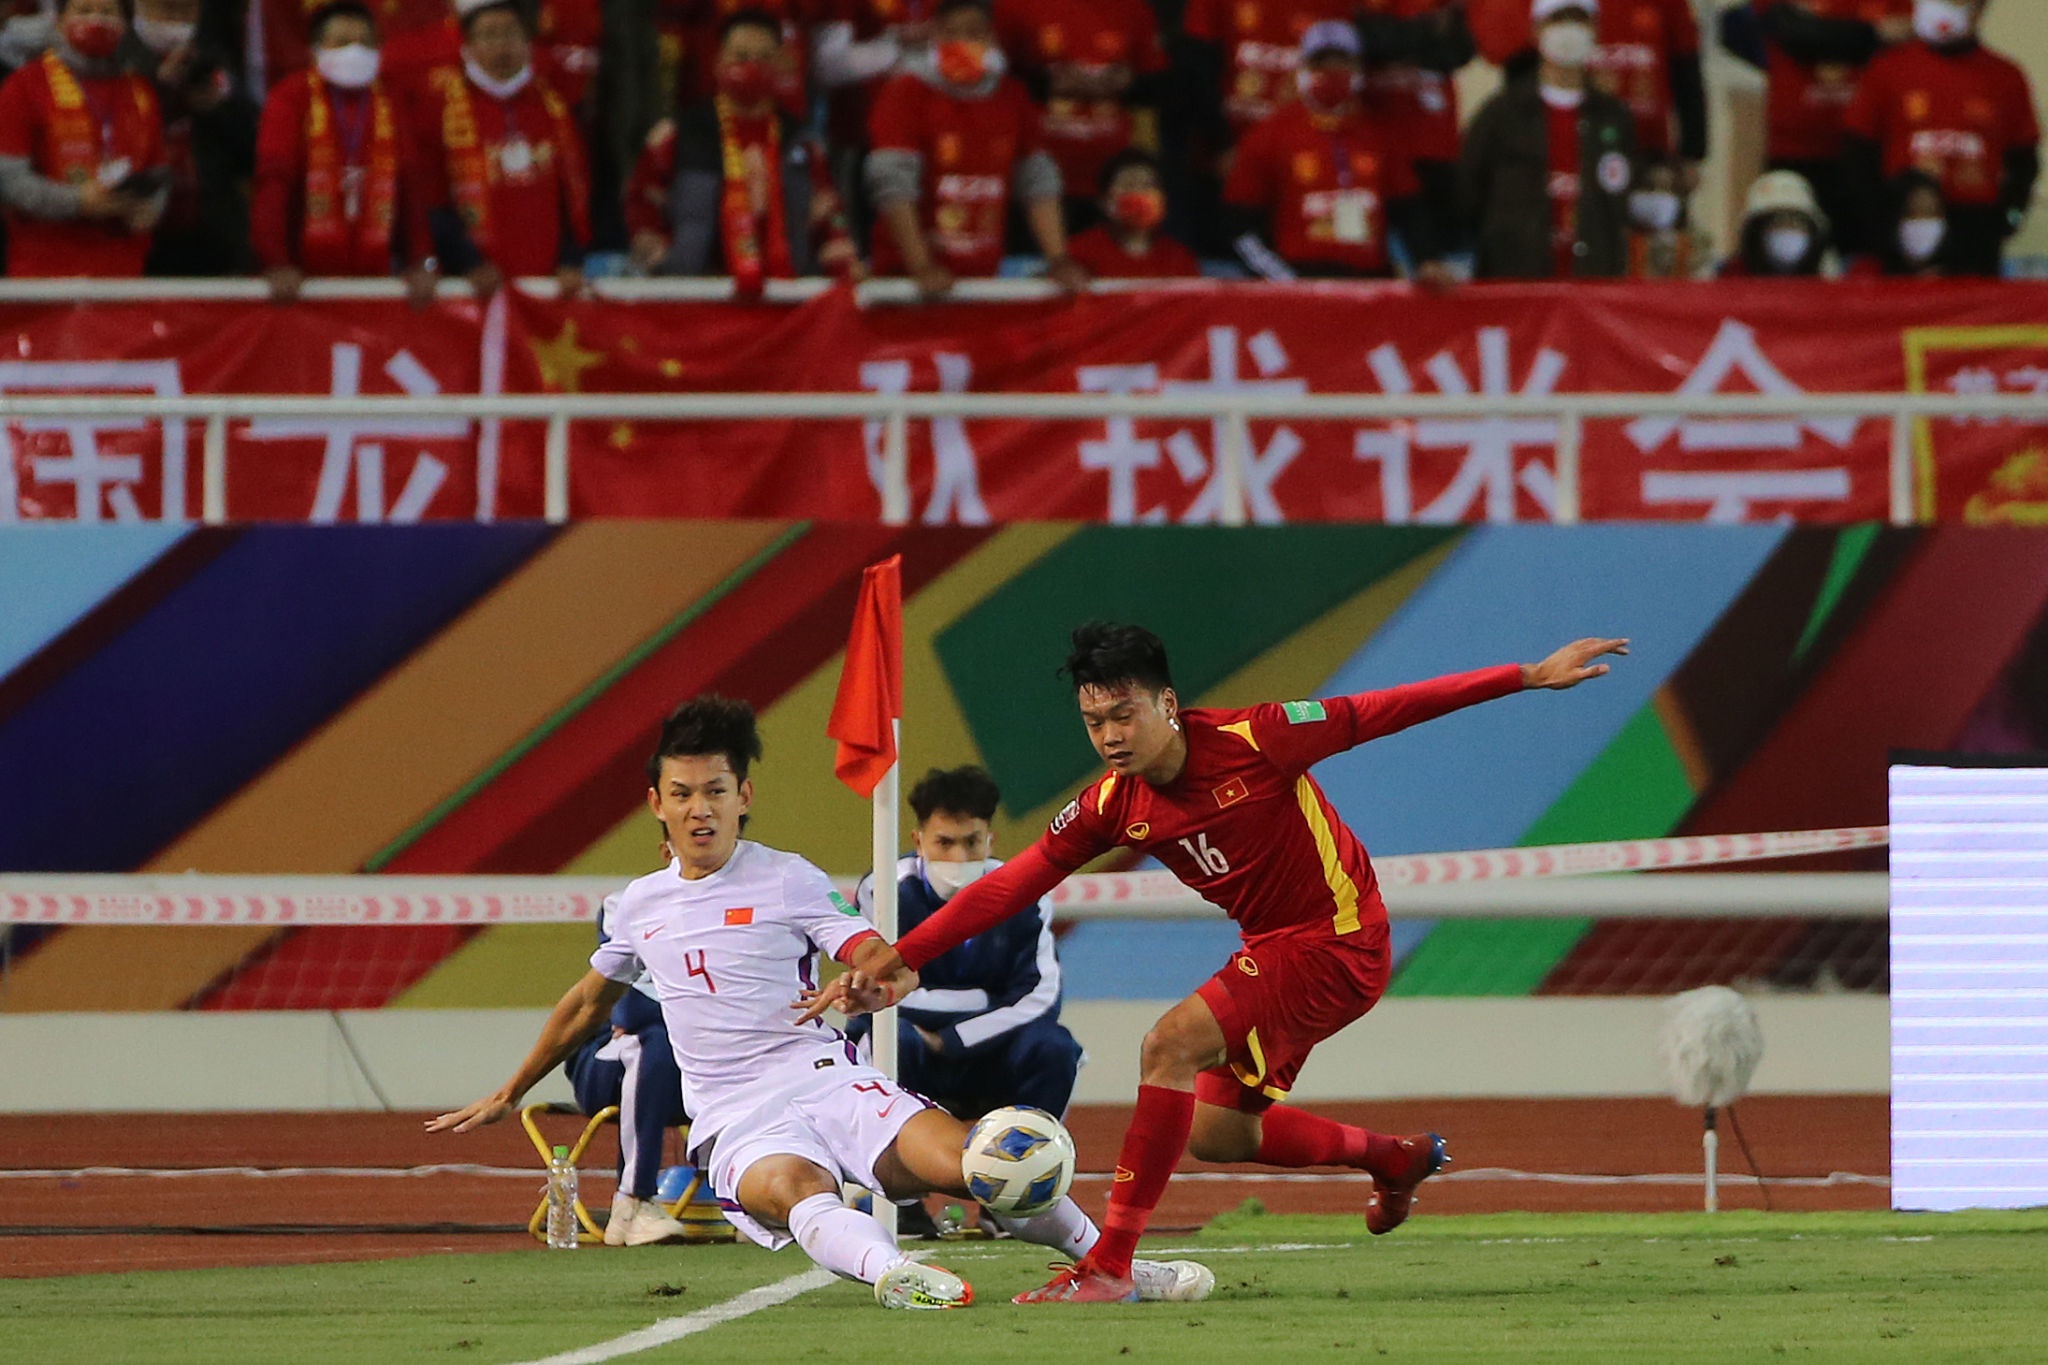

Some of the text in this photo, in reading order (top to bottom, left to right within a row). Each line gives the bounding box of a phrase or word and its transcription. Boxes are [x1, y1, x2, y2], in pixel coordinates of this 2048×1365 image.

[1178, 833, 1230, 876] 16
[684, 949, 717, 994] 4
[852, 1081, 891, 1097] 4
